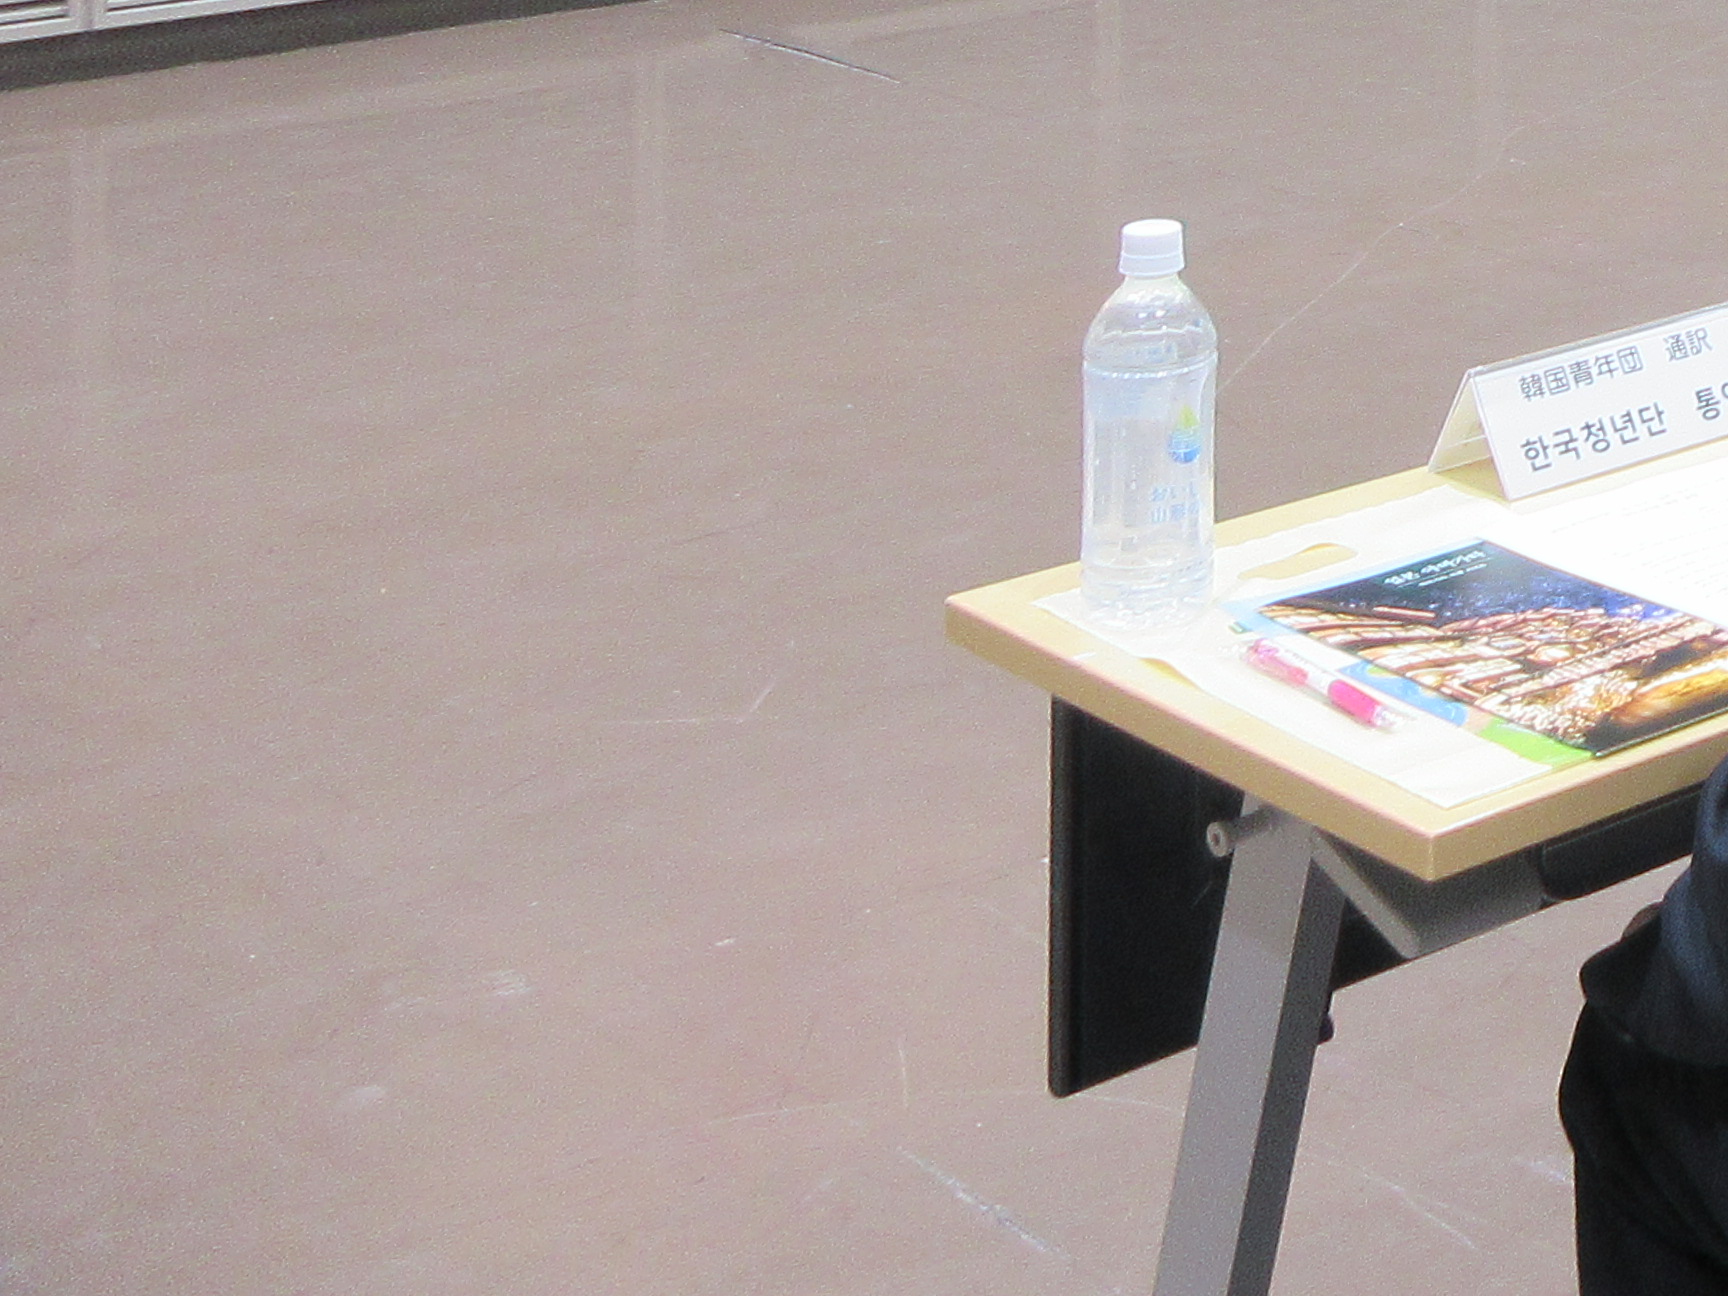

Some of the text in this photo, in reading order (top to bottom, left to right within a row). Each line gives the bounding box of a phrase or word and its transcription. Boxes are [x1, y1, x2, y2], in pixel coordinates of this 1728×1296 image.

[1519, 326, 1713, 401] 韓国青年団 通訳
[1520, 401, 1668, 472] 한국청년단
